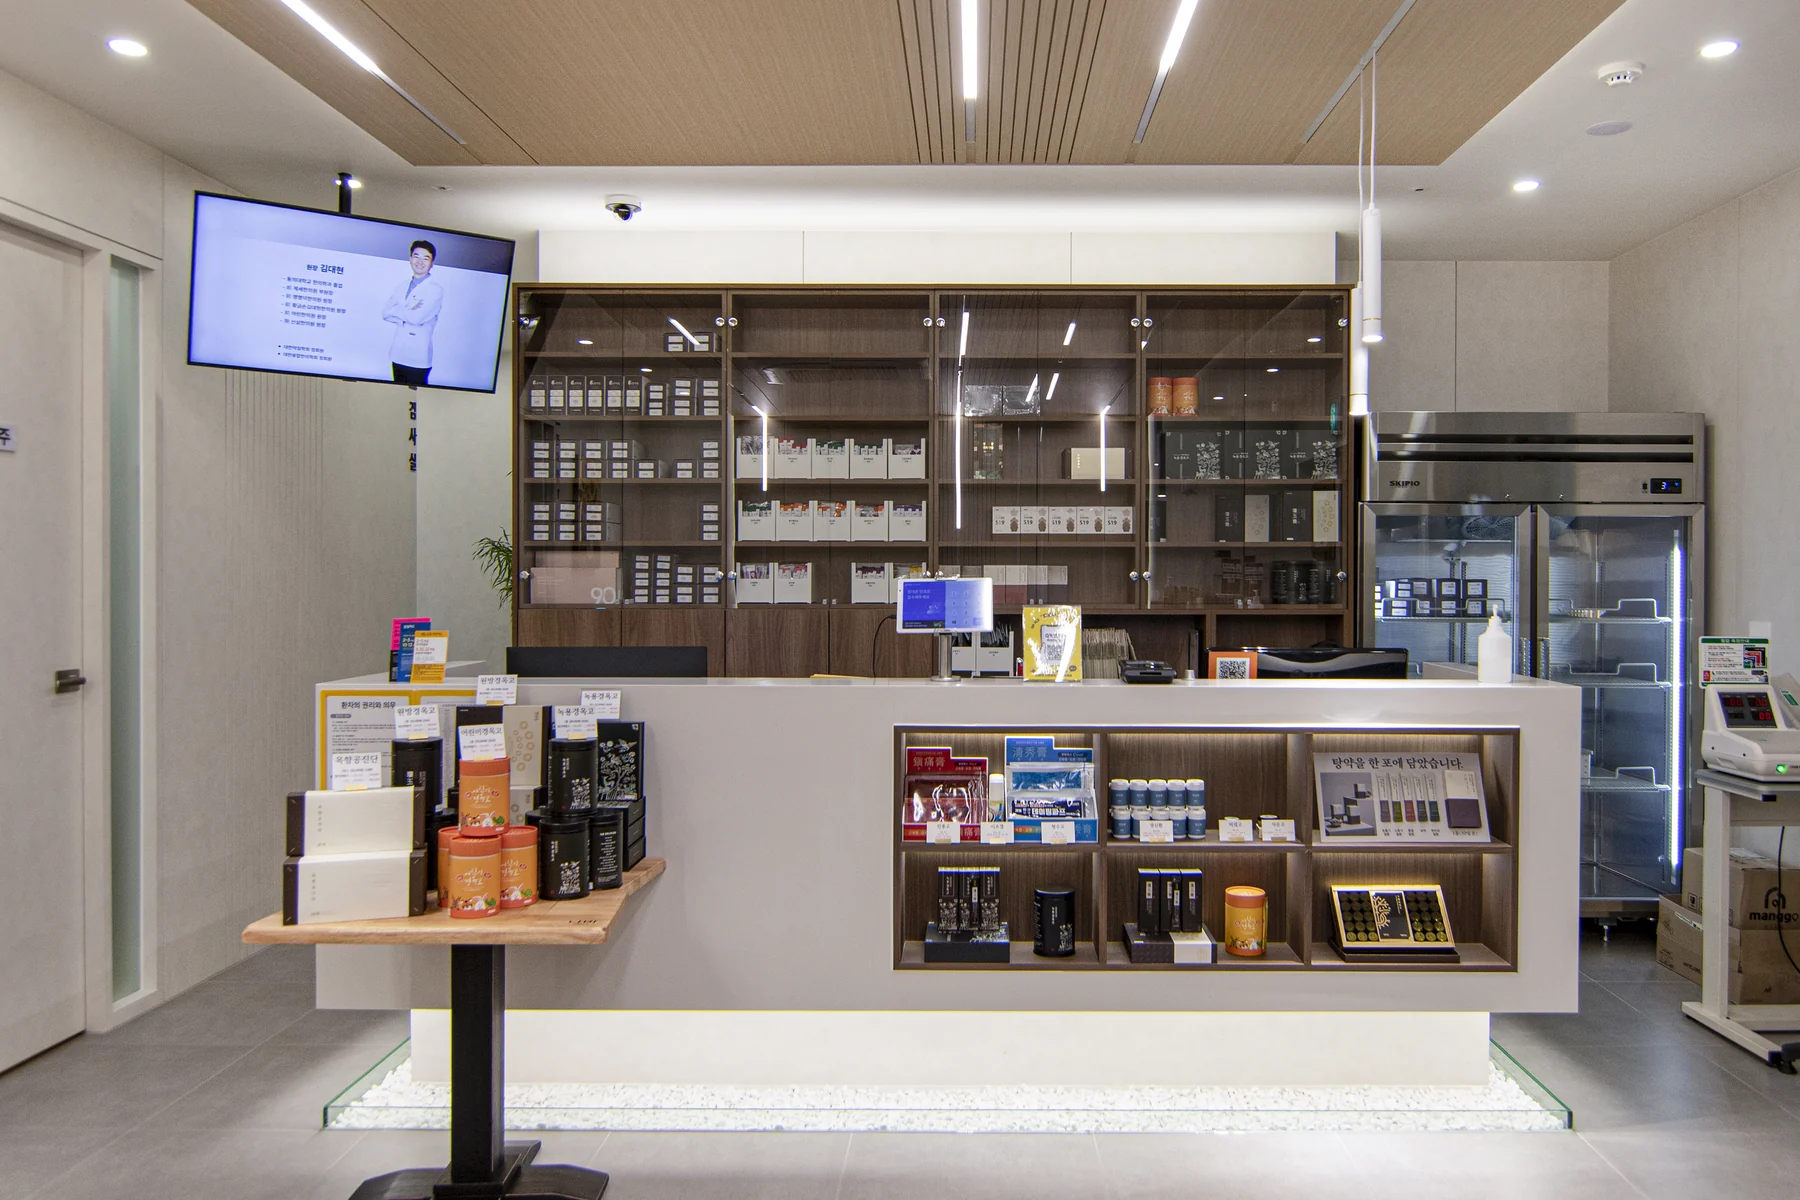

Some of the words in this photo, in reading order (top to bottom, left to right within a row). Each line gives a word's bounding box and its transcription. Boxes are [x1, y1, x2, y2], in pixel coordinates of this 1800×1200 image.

[320, 263, 344, 275] 김대현
[480, 677, 516, 685] 원방경옥고
[584, 692, 619, 700] 녹용경옥고
[341, 701, 361, 709] 환자의
[362, 701, 382, 709] 권리와
[383, 701, 396, 709] 의무
[397, 707, 437, 716] 원방경옥고
[557, 707, 595, 717] 녹용경옥고
[460, 727, 503, 736] 어린이경옥고
[336, 754, 379, 765] 옥향공진단
[1332, 757, 1365, 769] 탕약을
[1368, 757, 1380, 769] 한
[1382, 757, 1403, 769] 포에
[1406, 757, 1464, 770] 담았습니다.
